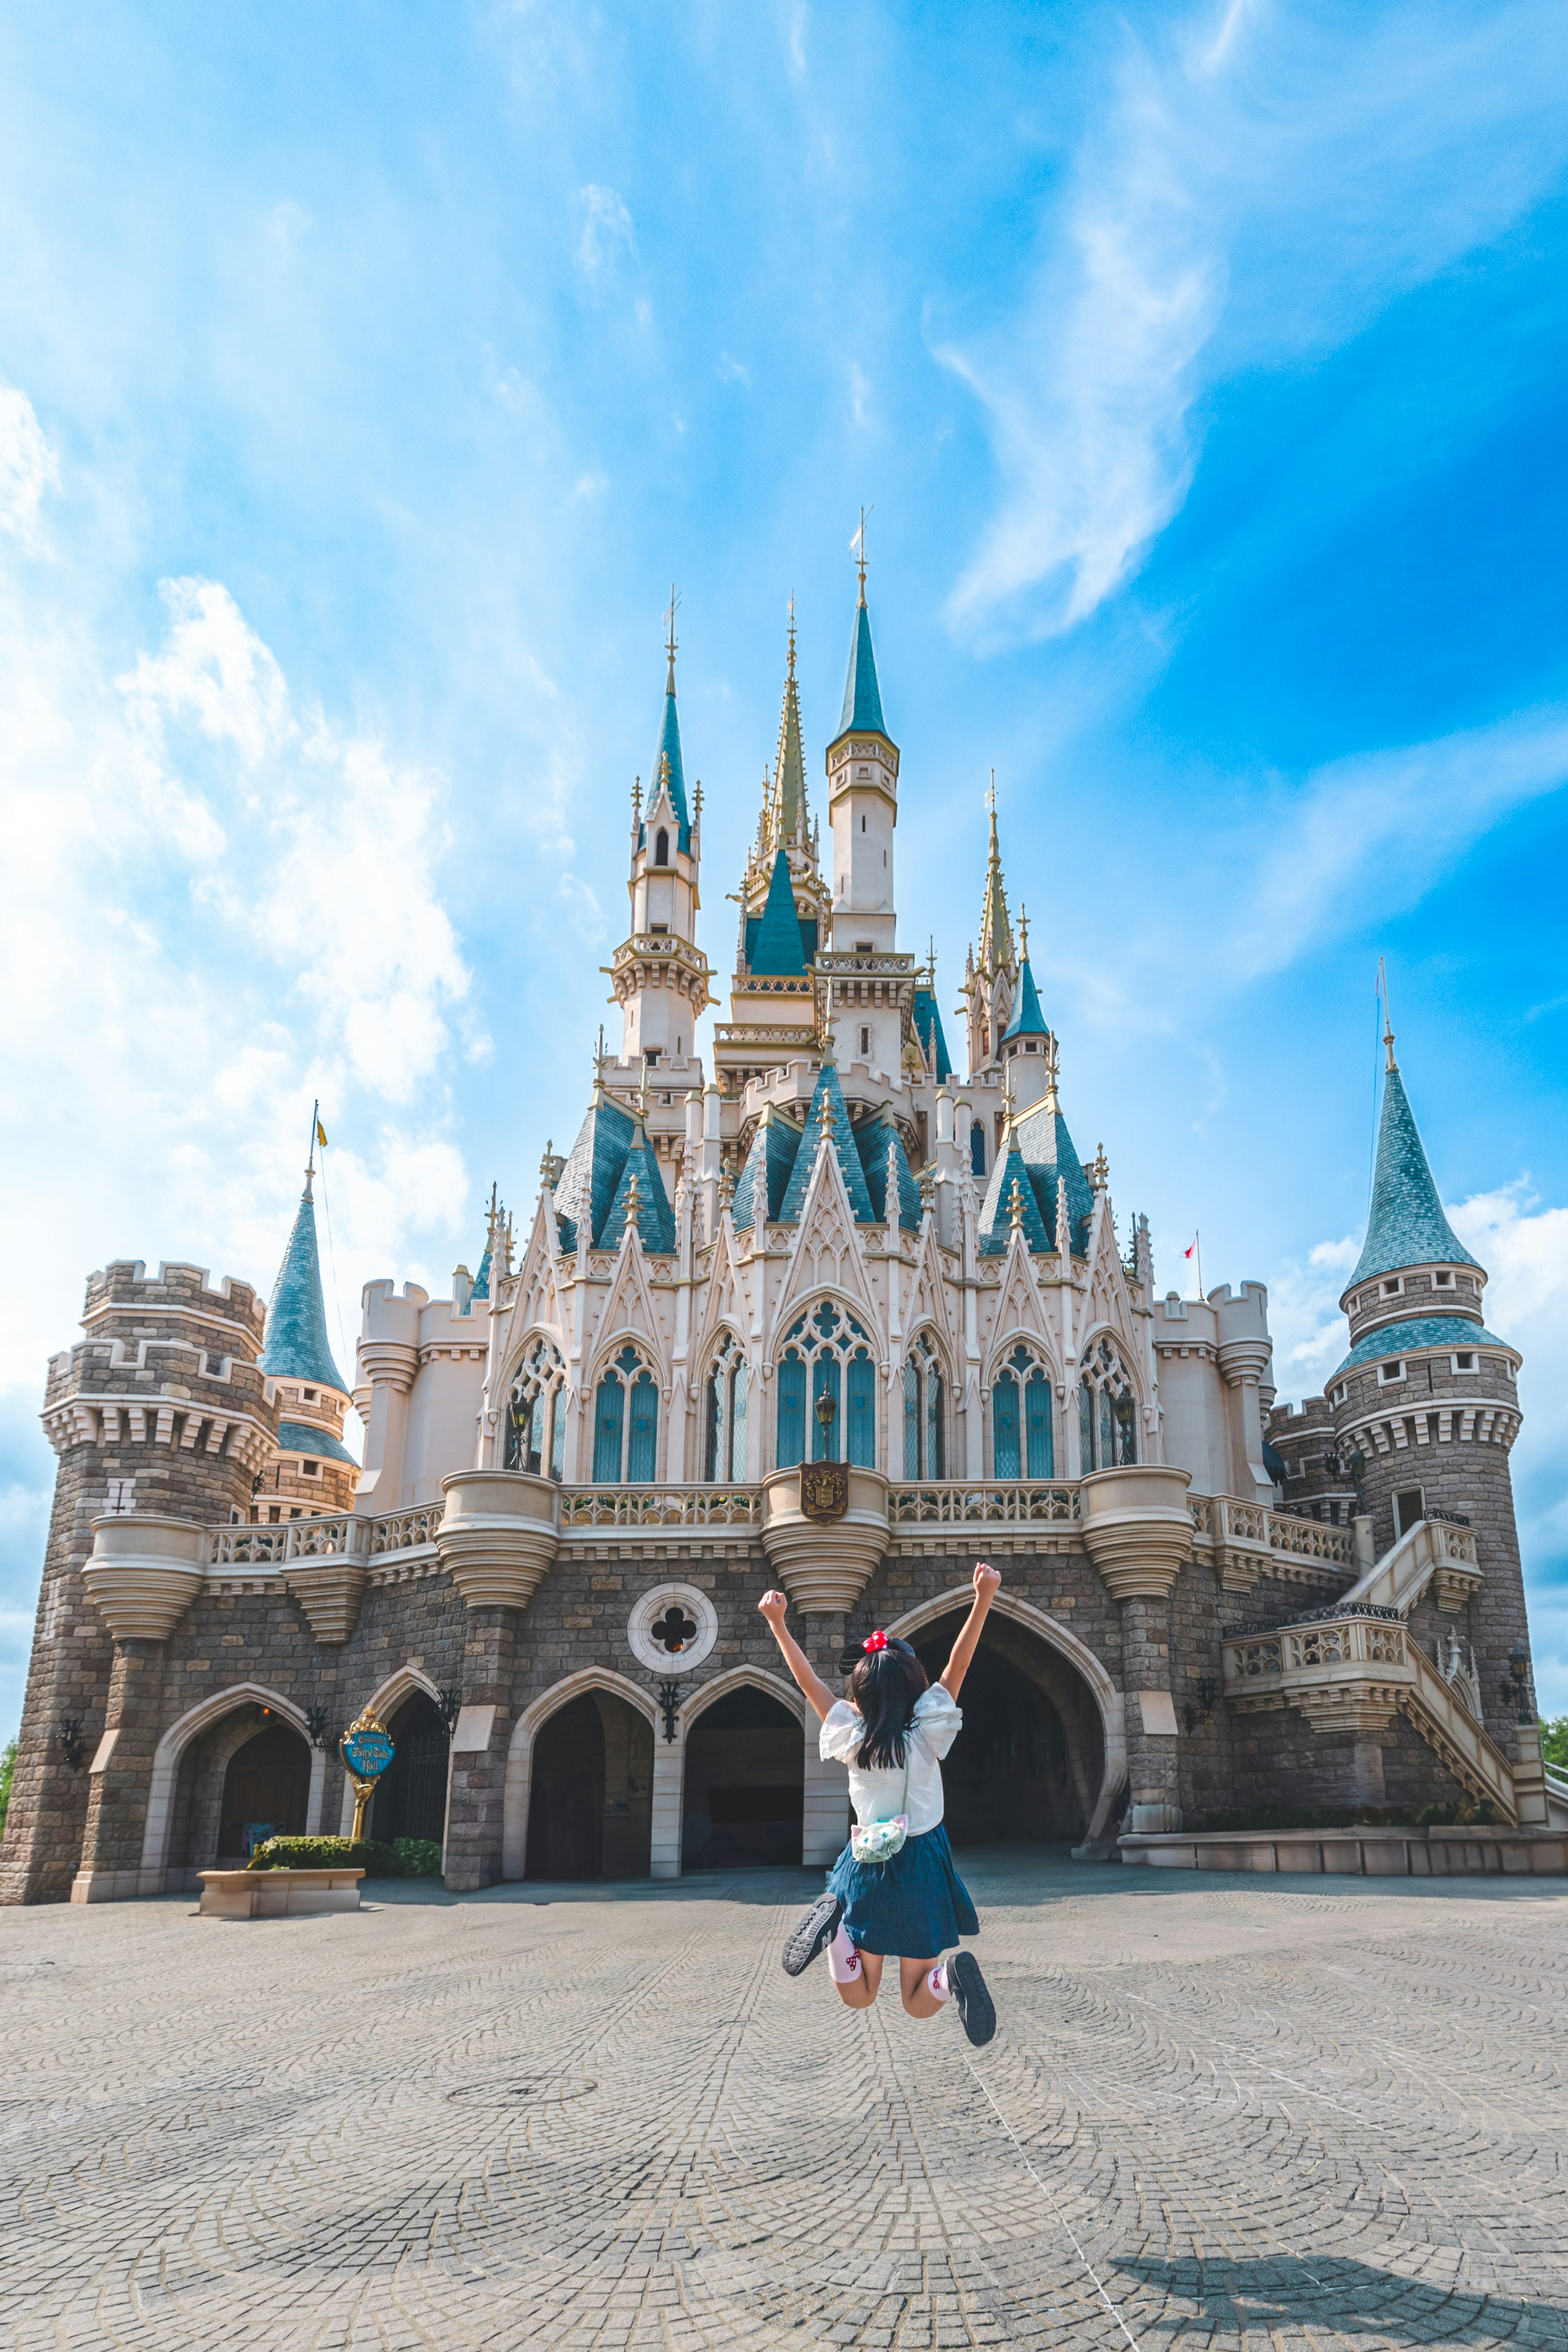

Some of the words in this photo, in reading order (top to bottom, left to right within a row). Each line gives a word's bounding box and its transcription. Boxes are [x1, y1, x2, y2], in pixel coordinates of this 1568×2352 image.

[352, 1747, 372, 1759] Fairy
[374, 1747, 388, 1759] Tale
[361, 1760, 378, 1772] Hall
